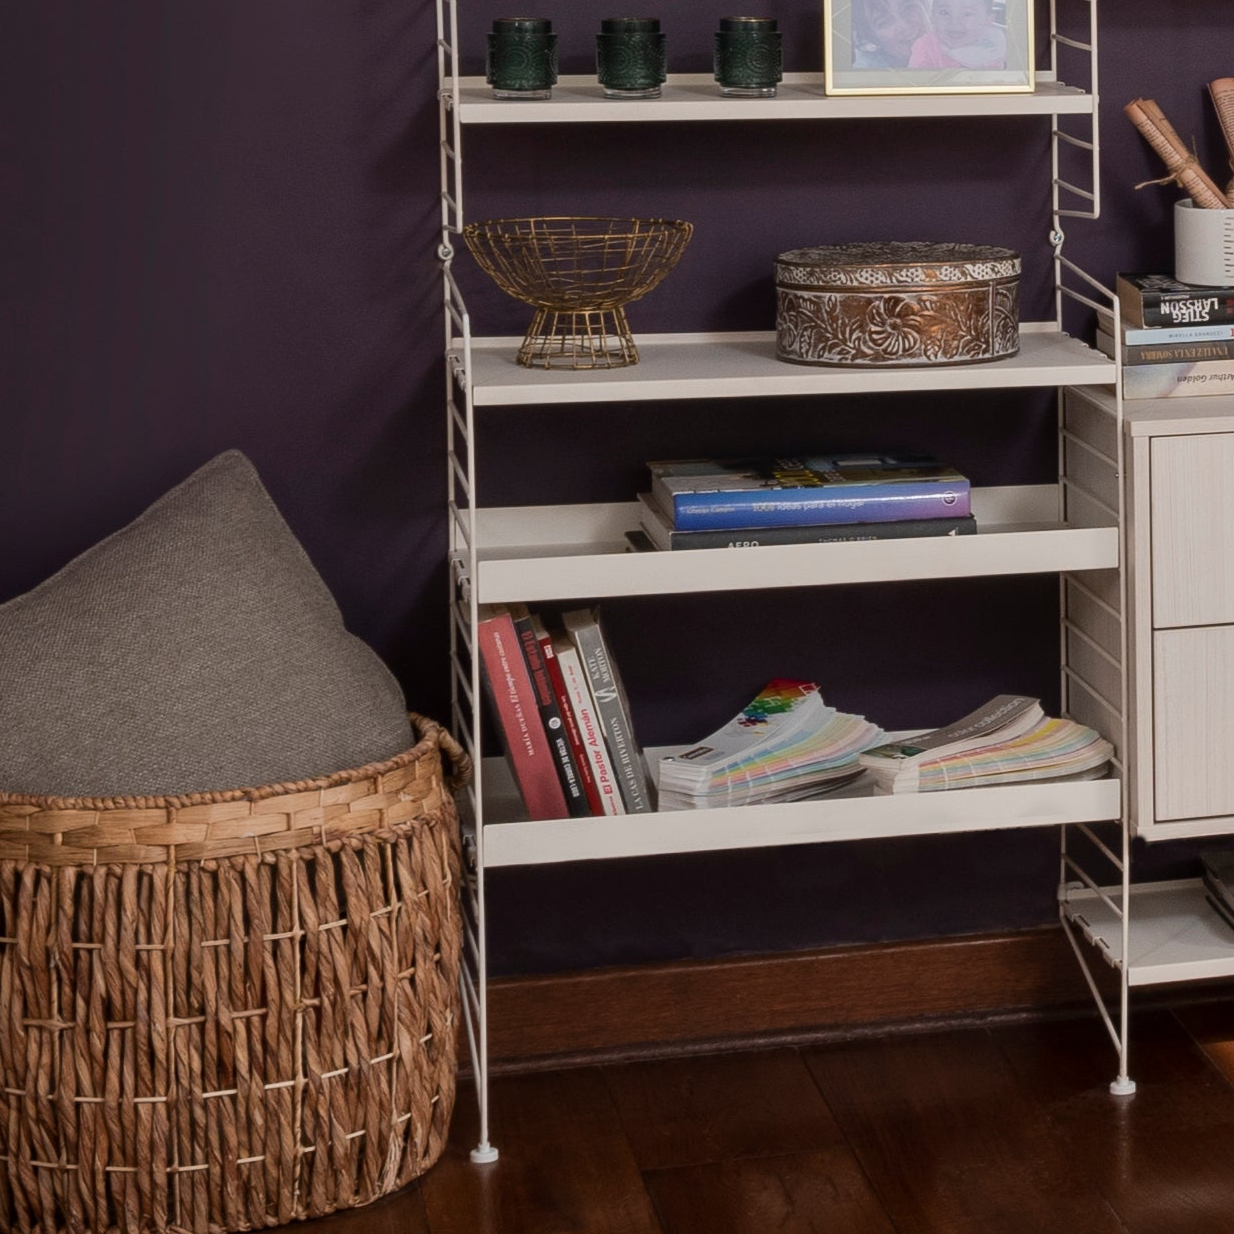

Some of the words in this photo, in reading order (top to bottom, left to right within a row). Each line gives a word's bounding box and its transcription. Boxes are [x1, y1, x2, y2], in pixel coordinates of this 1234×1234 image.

[1160, 297, 1219, 315] LARSSON
[1172, 309, 1210, 324] STIEG
[1176, 373, 1207, 383] Golden
[588, 657, 597, 680] KATE
[594, 648, 611, 683] MORTON
[580, 708, 597, 747] Alemán
[610, 717, 631, 765] RIVERTON
[594, 750, 610, 784] Pastor
